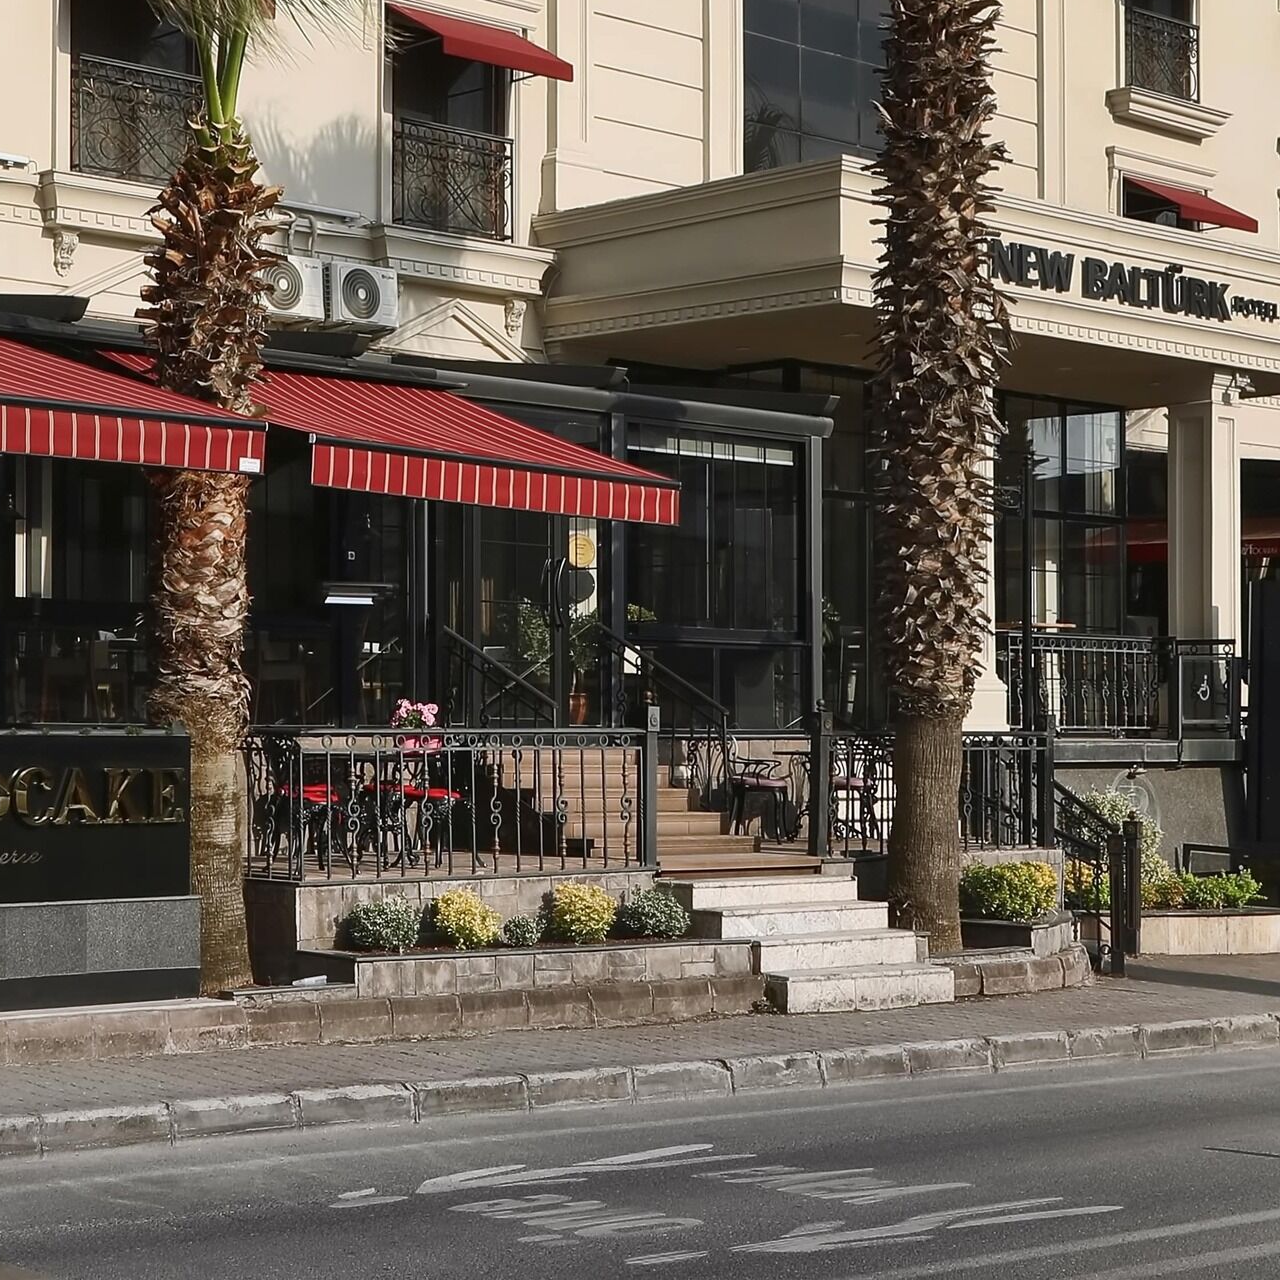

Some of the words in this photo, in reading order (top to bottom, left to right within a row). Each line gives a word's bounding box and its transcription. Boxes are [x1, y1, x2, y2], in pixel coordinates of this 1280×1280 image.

[988, 236, 1074, 294] NEW
[1081, 257, 1232, 322] BALTÜRK
[1230, 296, 1280, 323] HOTEL
